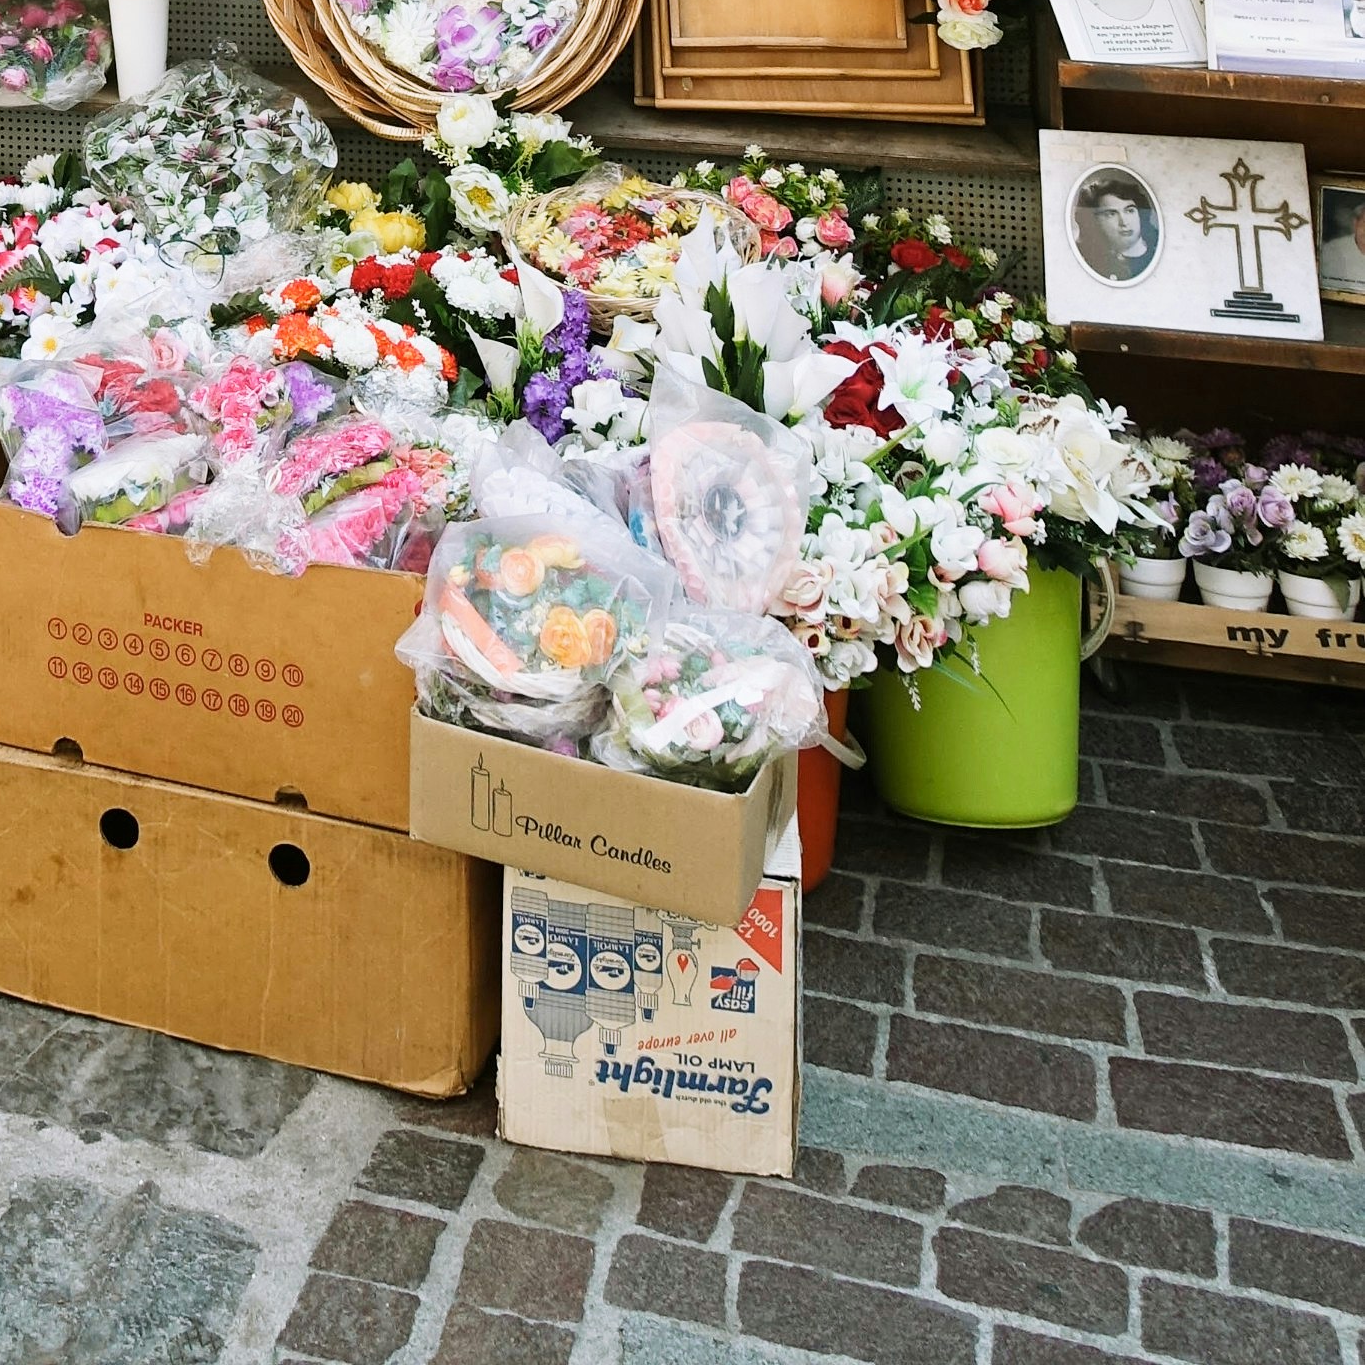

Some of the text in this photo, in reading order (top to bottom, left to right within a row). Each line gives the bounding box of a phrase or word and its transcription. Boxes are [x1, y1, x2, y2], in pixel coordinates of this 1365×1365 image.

[144, 613, 203, 637] PACKER
[1227, 625, 1289, 648] my
[515, 815, 672, 873] Pillar Candles
[714, 994, 750, 1011] easy
[732, 983, 755, 1001] fill
[637, 1028, 737, 1051] all over europe
[673, 1052, 755, 1073] LAMP OIL
[595, 1055, 773, 1114] Farmlight
